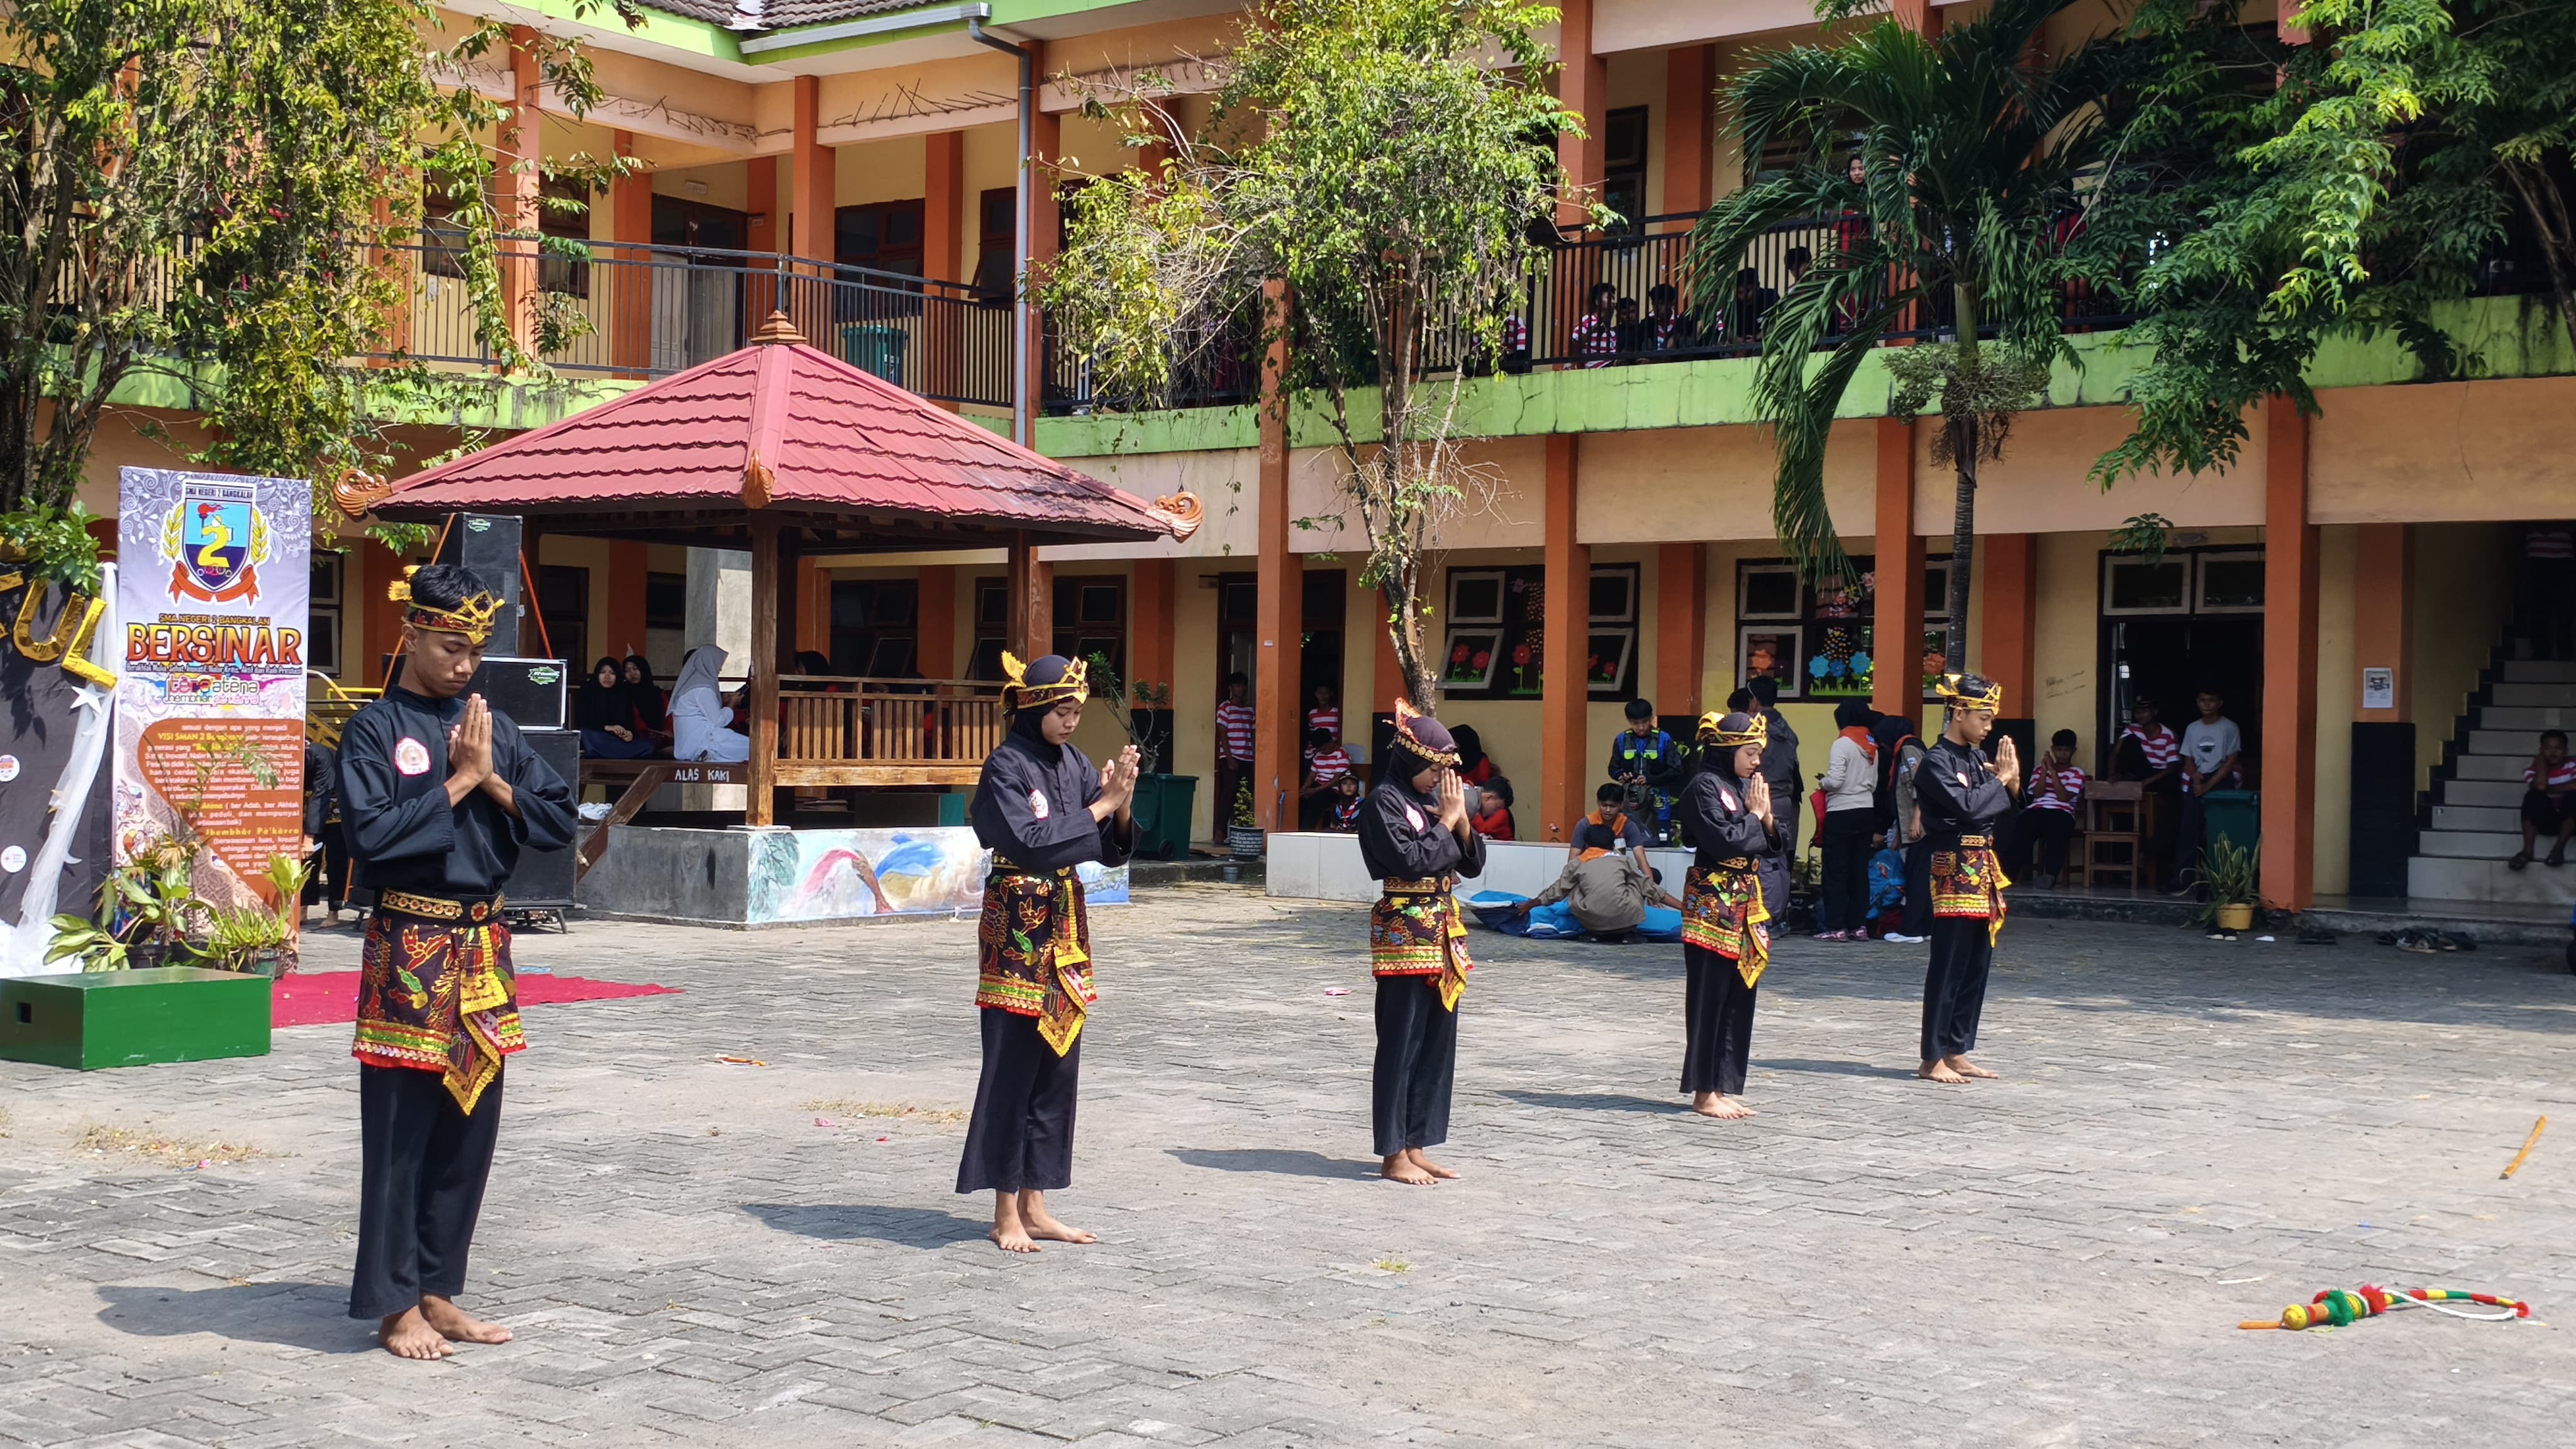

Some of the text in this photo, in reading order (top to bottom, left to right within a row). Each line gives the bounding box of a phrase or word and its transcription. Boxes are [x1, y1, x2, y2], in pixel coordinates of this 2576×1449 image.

[158, 613, 270, 626] SMA NEGERI 2 BANGKALAN
[126, 623, 303, 664] BERSINAR
[675, 768, 730, 782] ALAS KAKI
